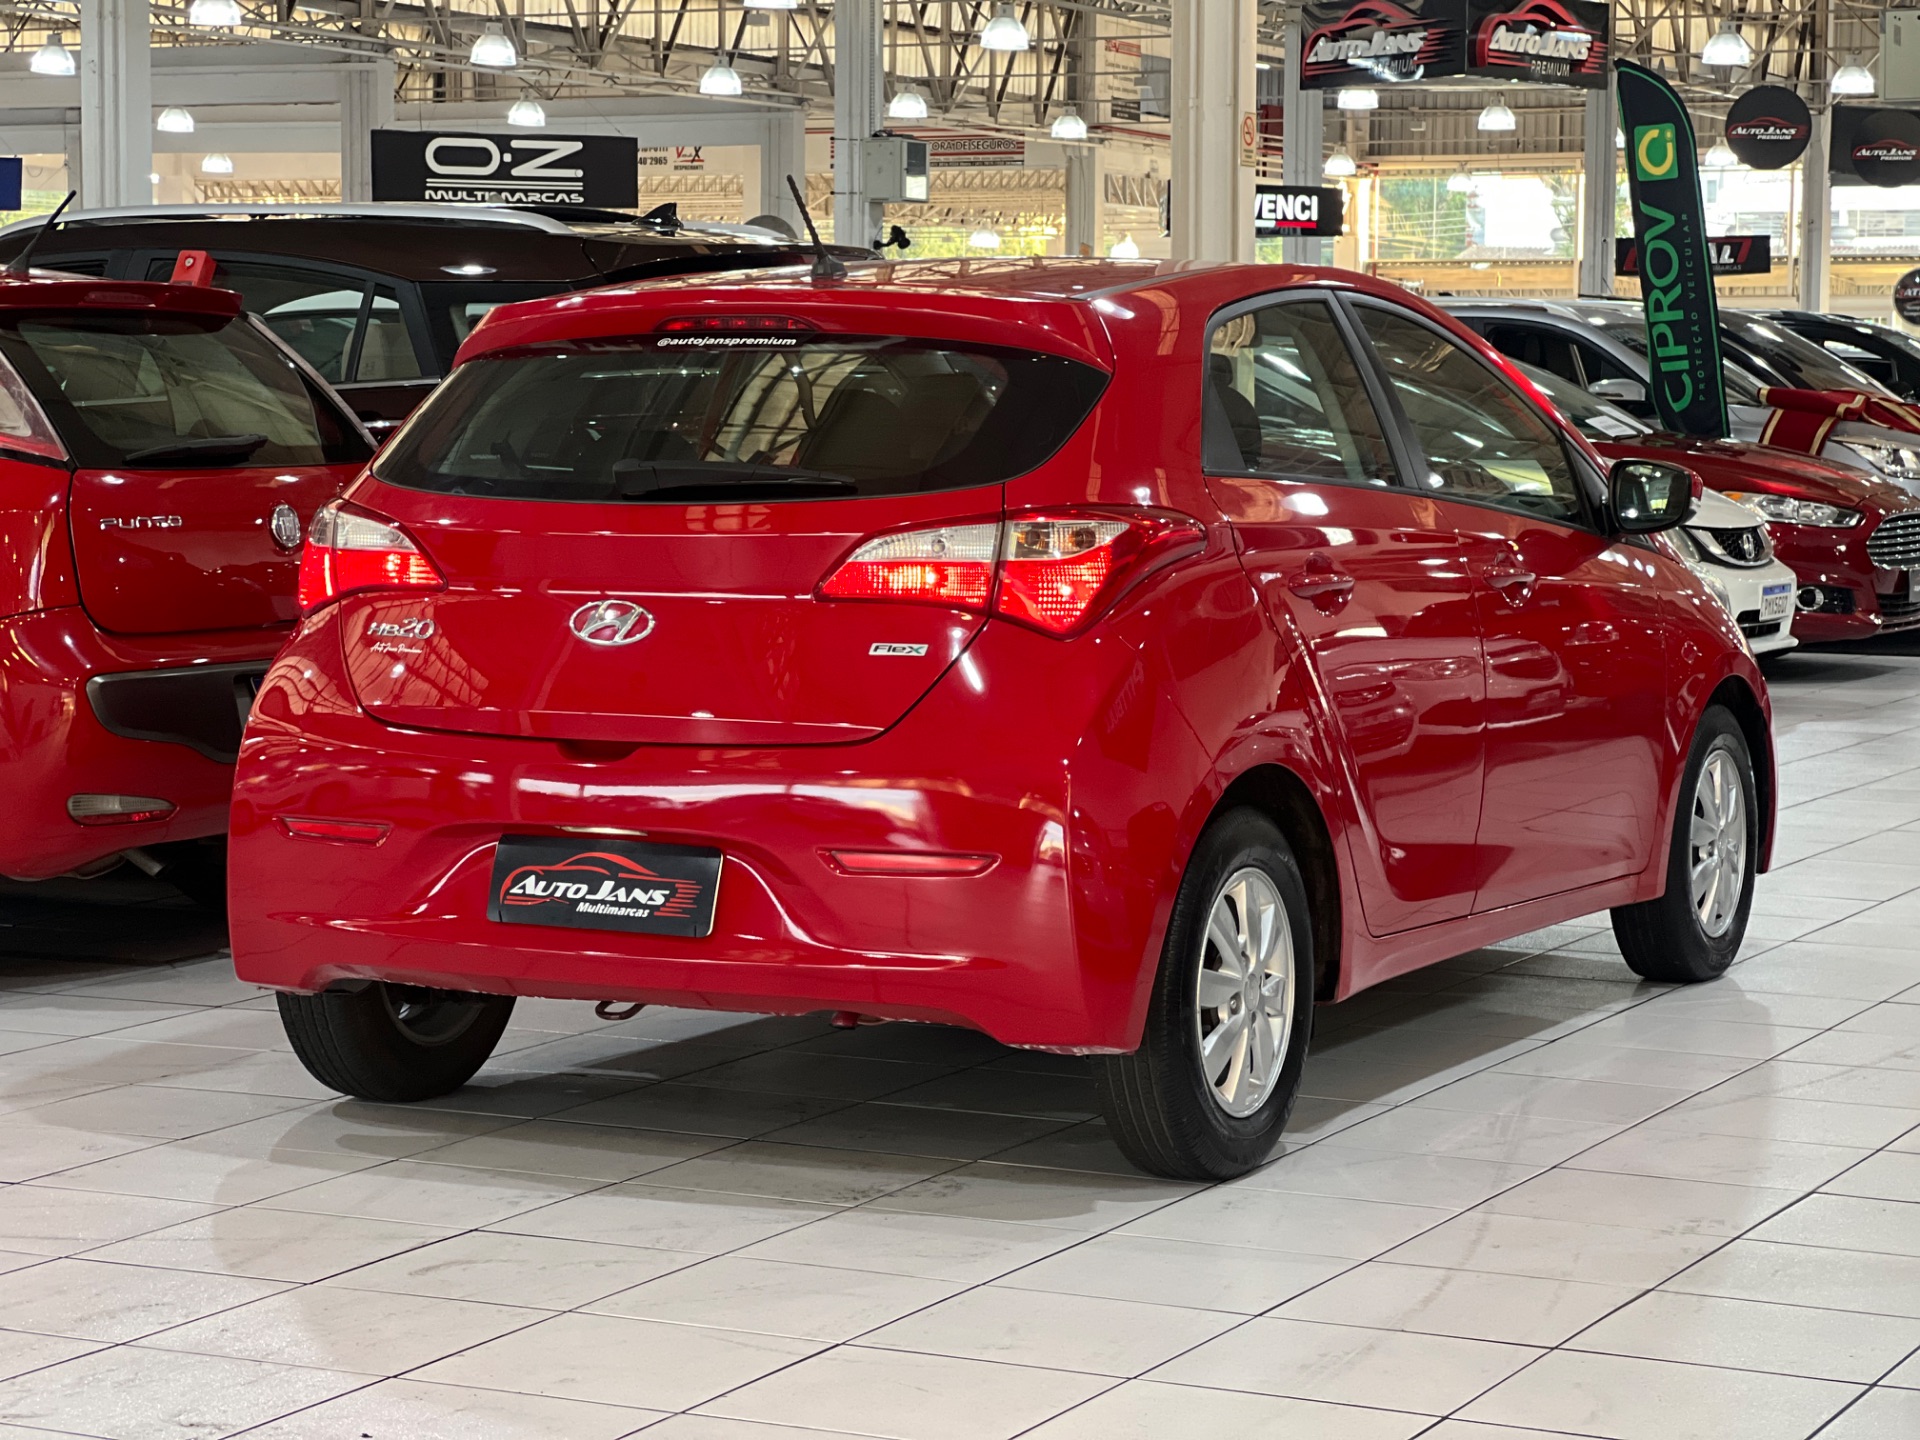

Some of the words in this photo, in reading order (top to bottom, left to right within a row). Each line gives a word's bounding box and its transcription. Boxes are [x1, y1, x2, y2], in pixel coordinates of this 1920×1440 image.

[1531, 60, 1570, 77] PREMIUM
[970, 139, 1017, 150] SEGUROS
[1681, 213, 1696, 300] VEICULAR
[1639, 200, 1694, 413] CIPROV
[657, 336, 797, 347] @autojanspremium
[1690, 312, 1706, 401] PROTEÇÃO
[100, 515, 183, 530] PUNTO
[367, 617, 435, 640] HB20
[873, 644, 926, 655] Flex
[576, 901, 650, 918] Multimarcas
